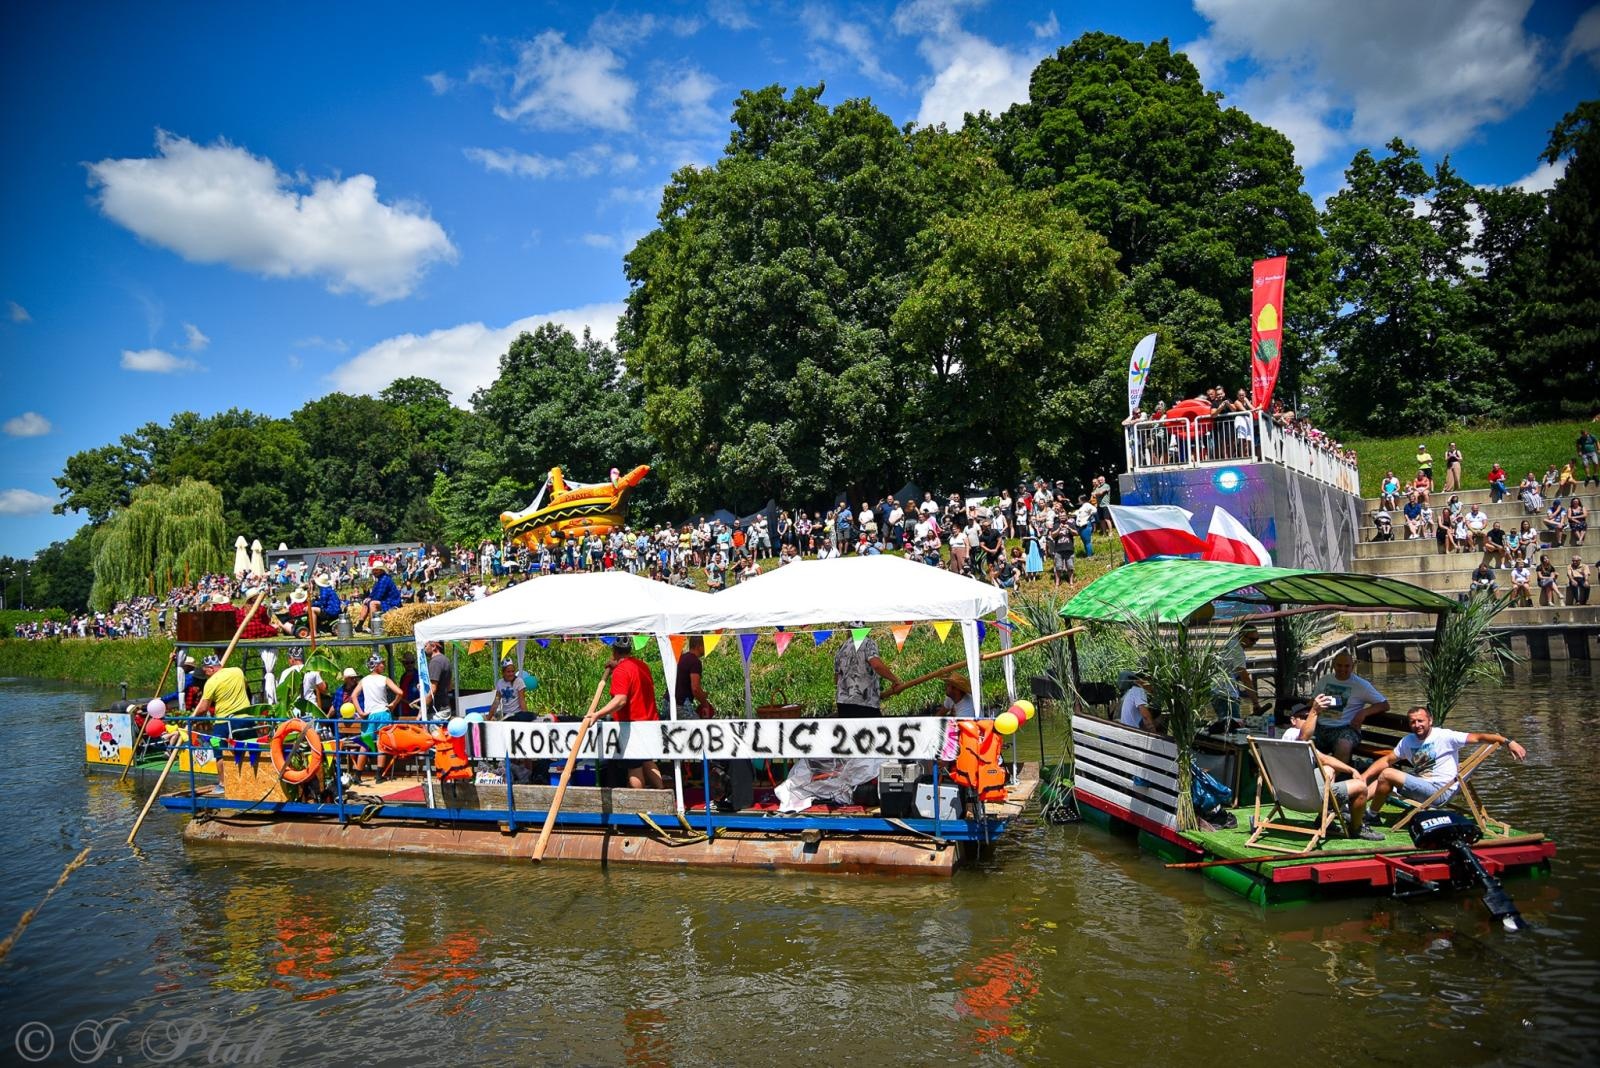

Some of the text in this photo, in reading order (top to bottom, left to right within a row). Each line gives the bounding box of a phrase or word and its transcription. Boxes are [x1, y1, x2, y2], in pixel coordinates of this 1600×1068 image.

[510, 721, 921, 757] KORONA KOBYLIC 2025
